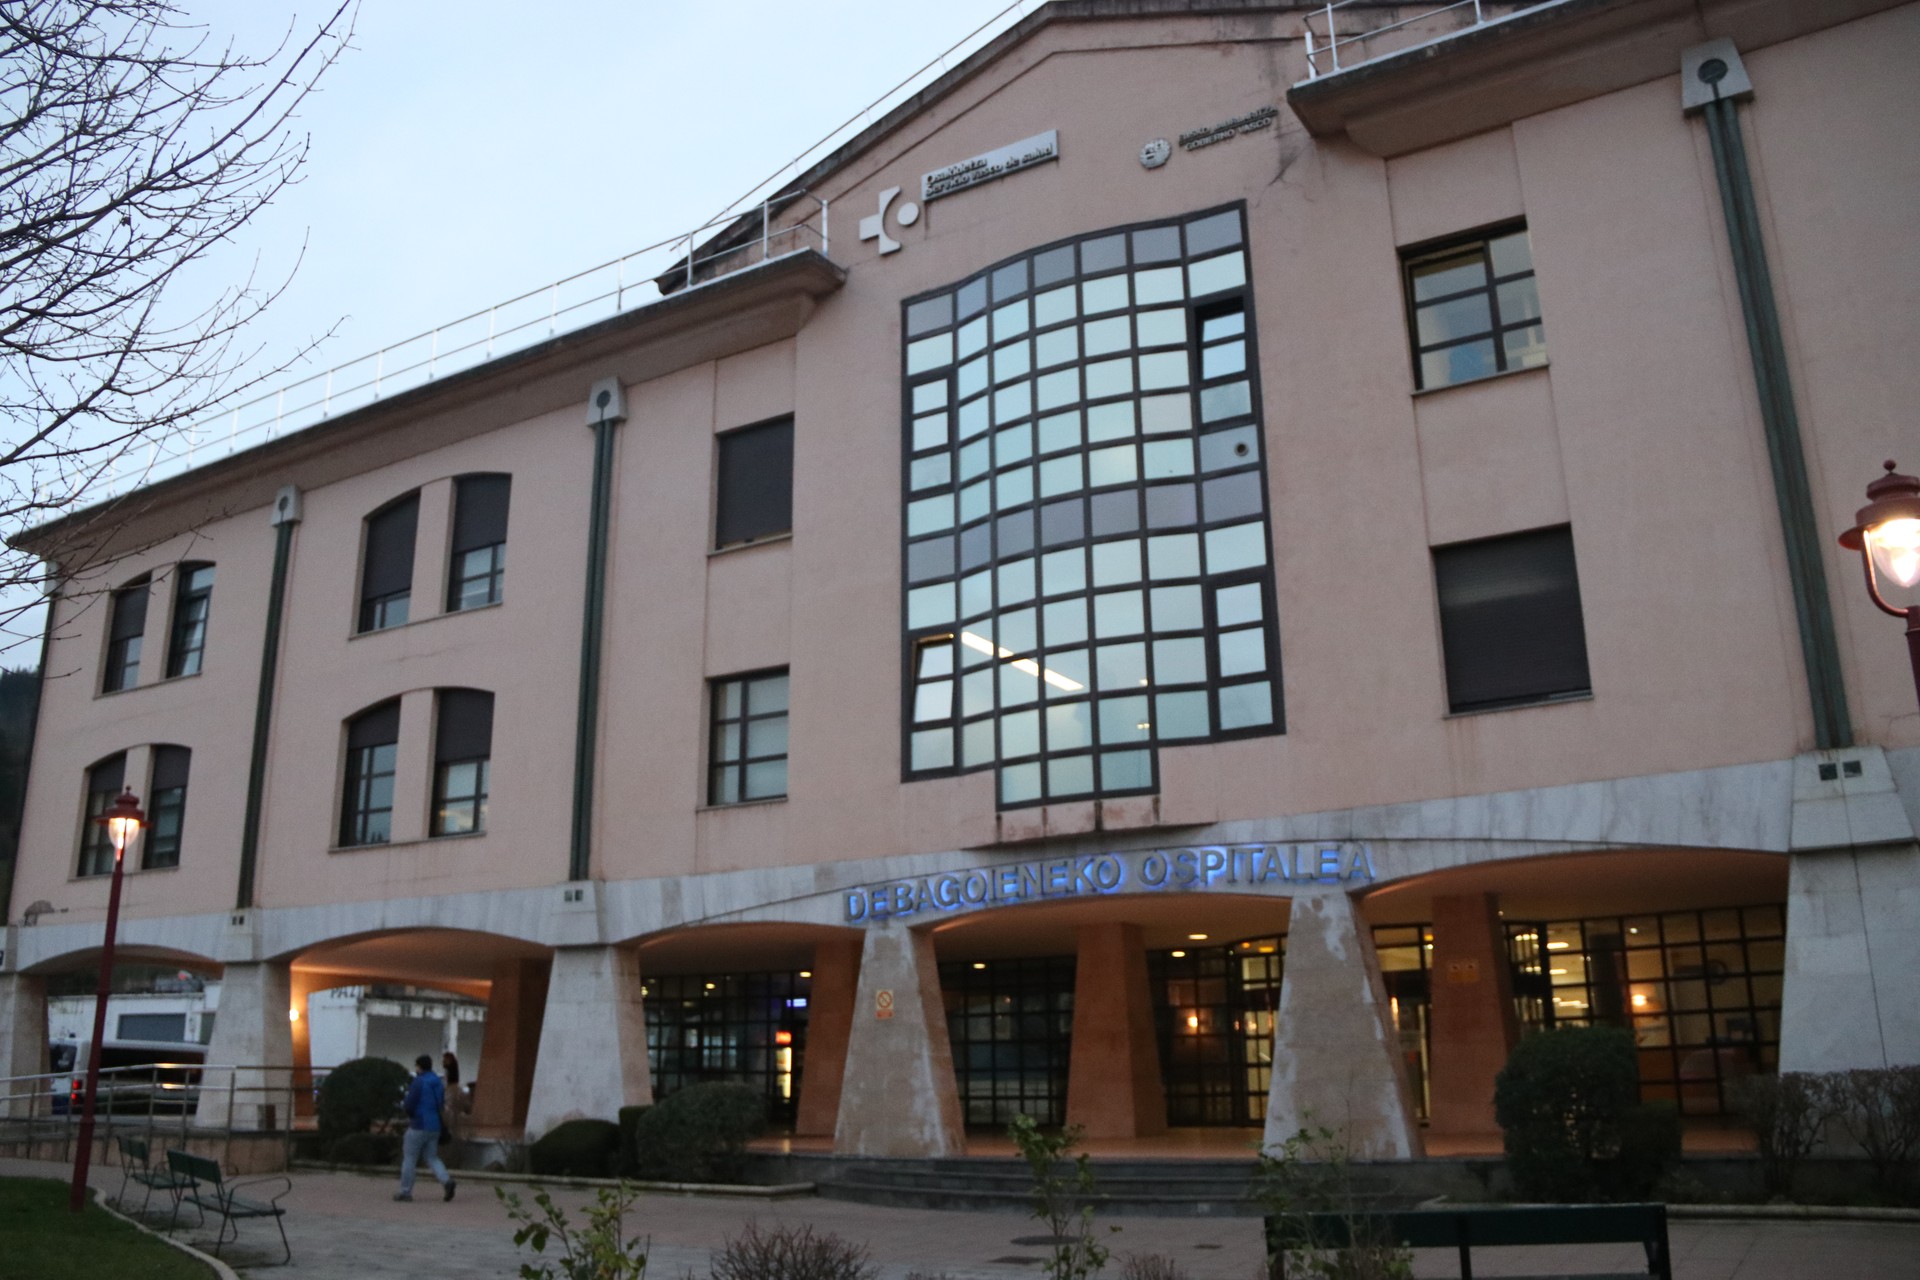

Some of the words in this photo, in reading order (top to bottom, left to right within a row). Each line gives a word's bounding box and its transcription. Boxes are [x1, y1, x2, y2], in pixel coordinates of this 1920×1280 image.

[1184, 129, 1235, 151] GOBIERNO
[1238, 117, 1272, 135] VASCO
[843, 854, 1120, 921] DEBAGOIENEKO
[1137, 842, 1375, 886] OSPITALEA
